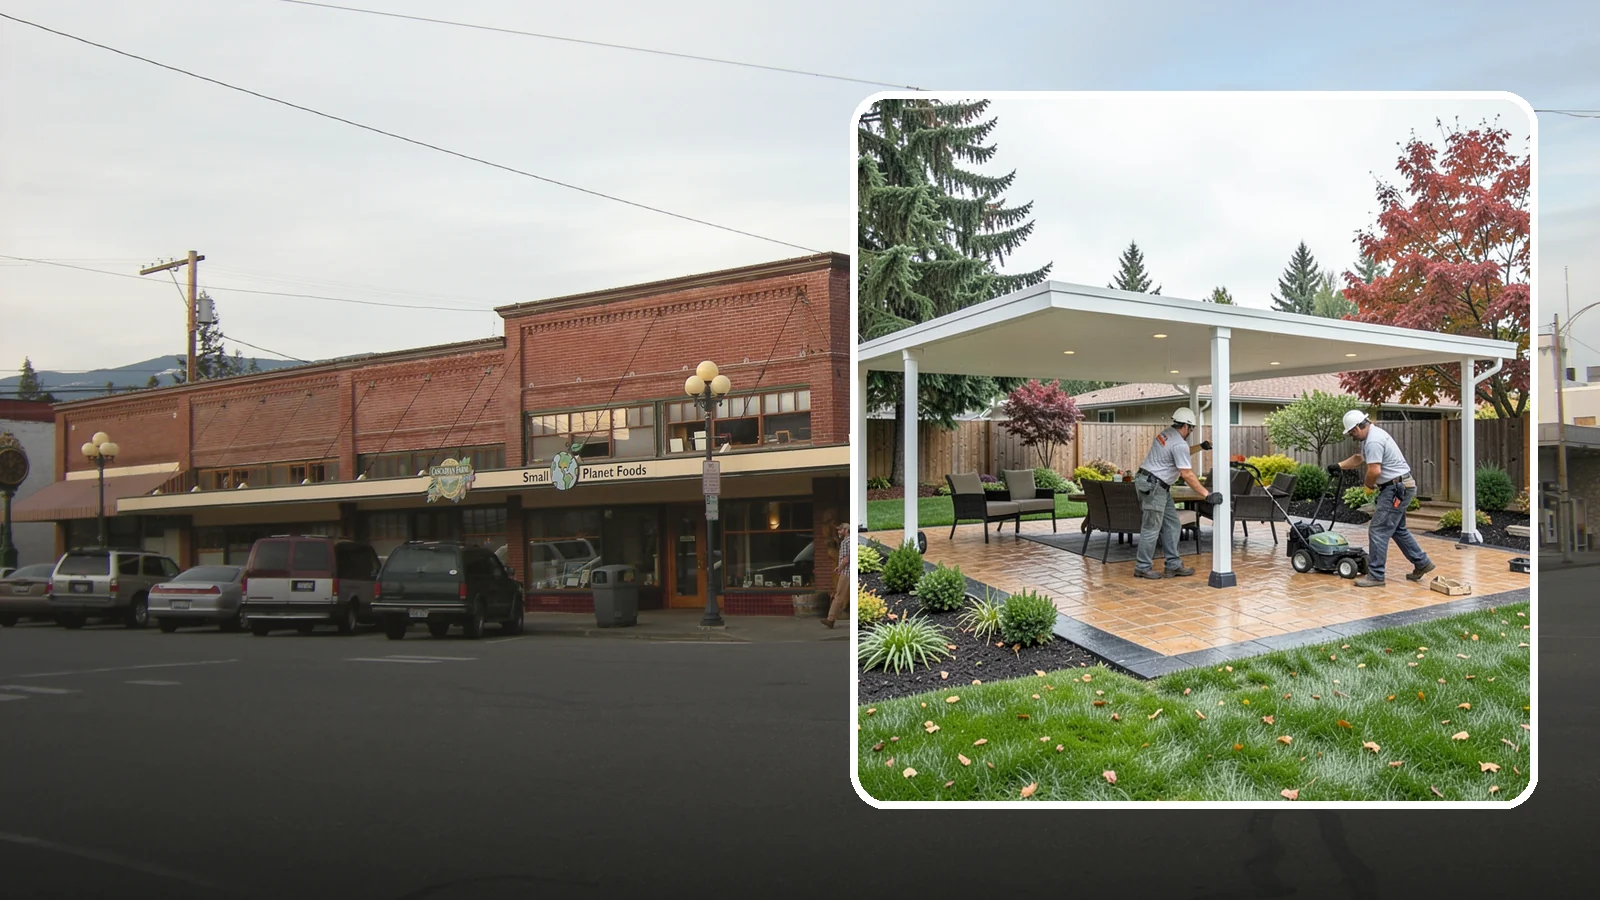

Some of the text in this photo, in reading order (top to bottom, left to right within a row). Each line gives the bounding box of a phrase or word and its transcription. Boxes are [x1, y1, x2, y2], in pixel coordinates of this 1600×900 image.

[523, 464, 647, 483] Small Planet Foods
